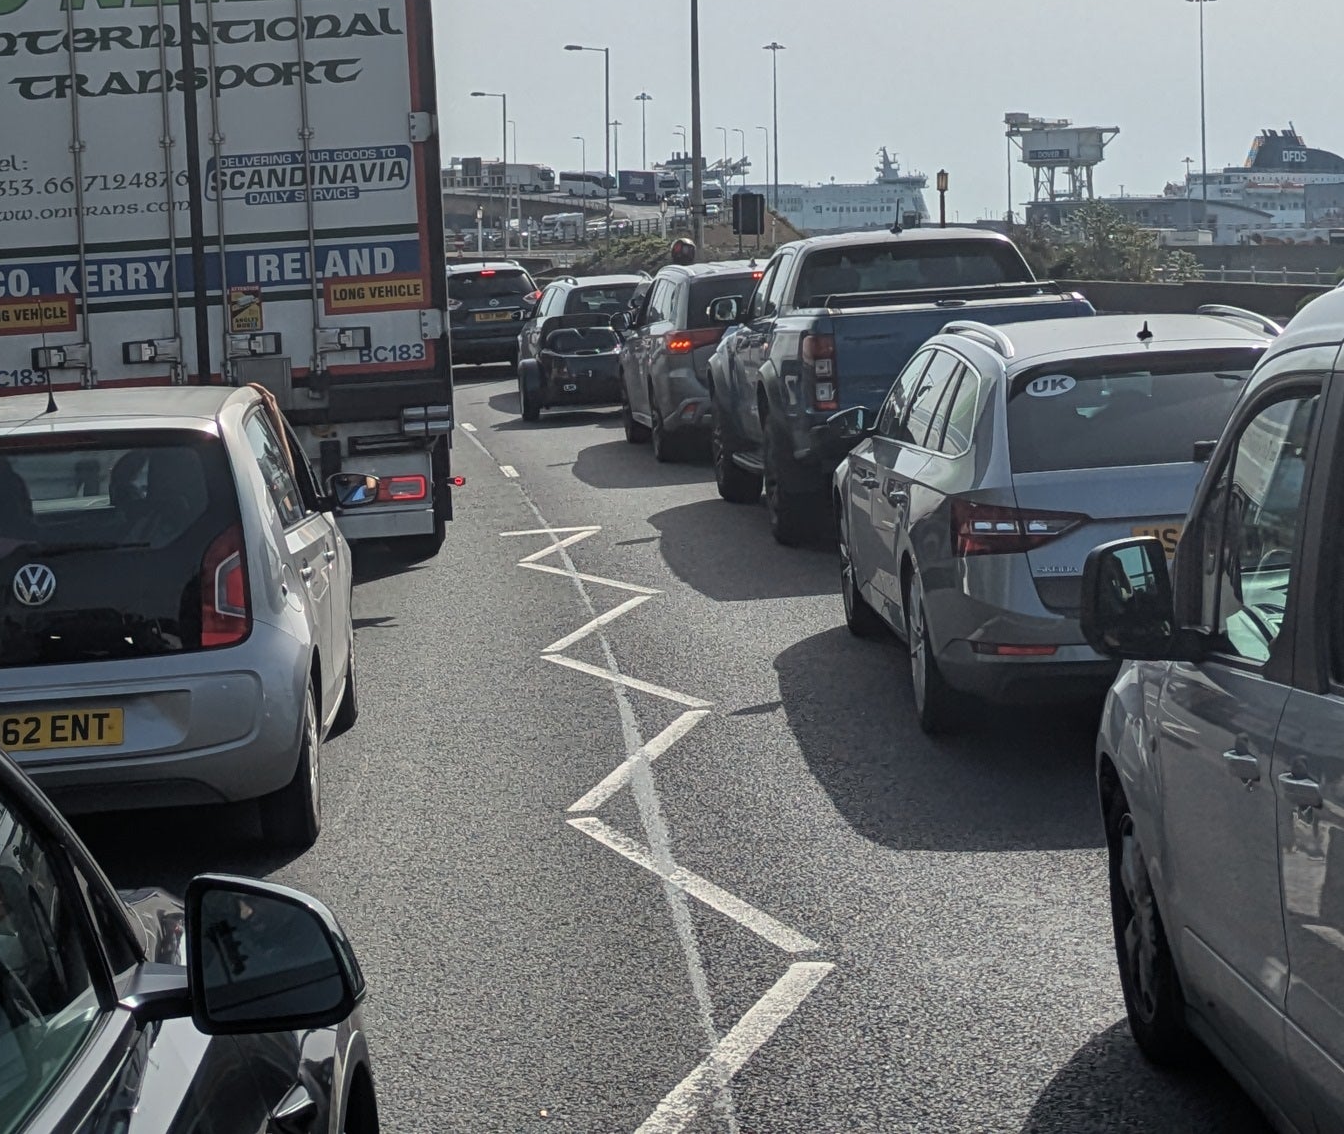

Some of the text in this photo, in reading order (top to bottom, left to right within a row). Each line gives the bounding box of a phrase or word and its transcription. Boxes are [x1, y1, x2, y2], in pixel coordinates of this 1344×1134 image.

[8, 58, 363, 101] TRANSPORT
[220, 147, 397, 167] DELIVERING YUR GOODS TO
[1282, 150, 1307, 162] DFDS
[211, 160, 405, 193] SCANDINAVIA
[249, 187, 357, 205] DAILY SRVICE
[246, 247, 395, 284] IRELAND
[55, 260, 171, 295] KERRY
[334, 283, 421, 302] LONG VEHICLE
[13, 306, 68, 321] VEHICLE
[360, 343, 425, 364] BC183
[1032, 378, 1068, 393] UK
[50, 712, 110, 743] ENT
